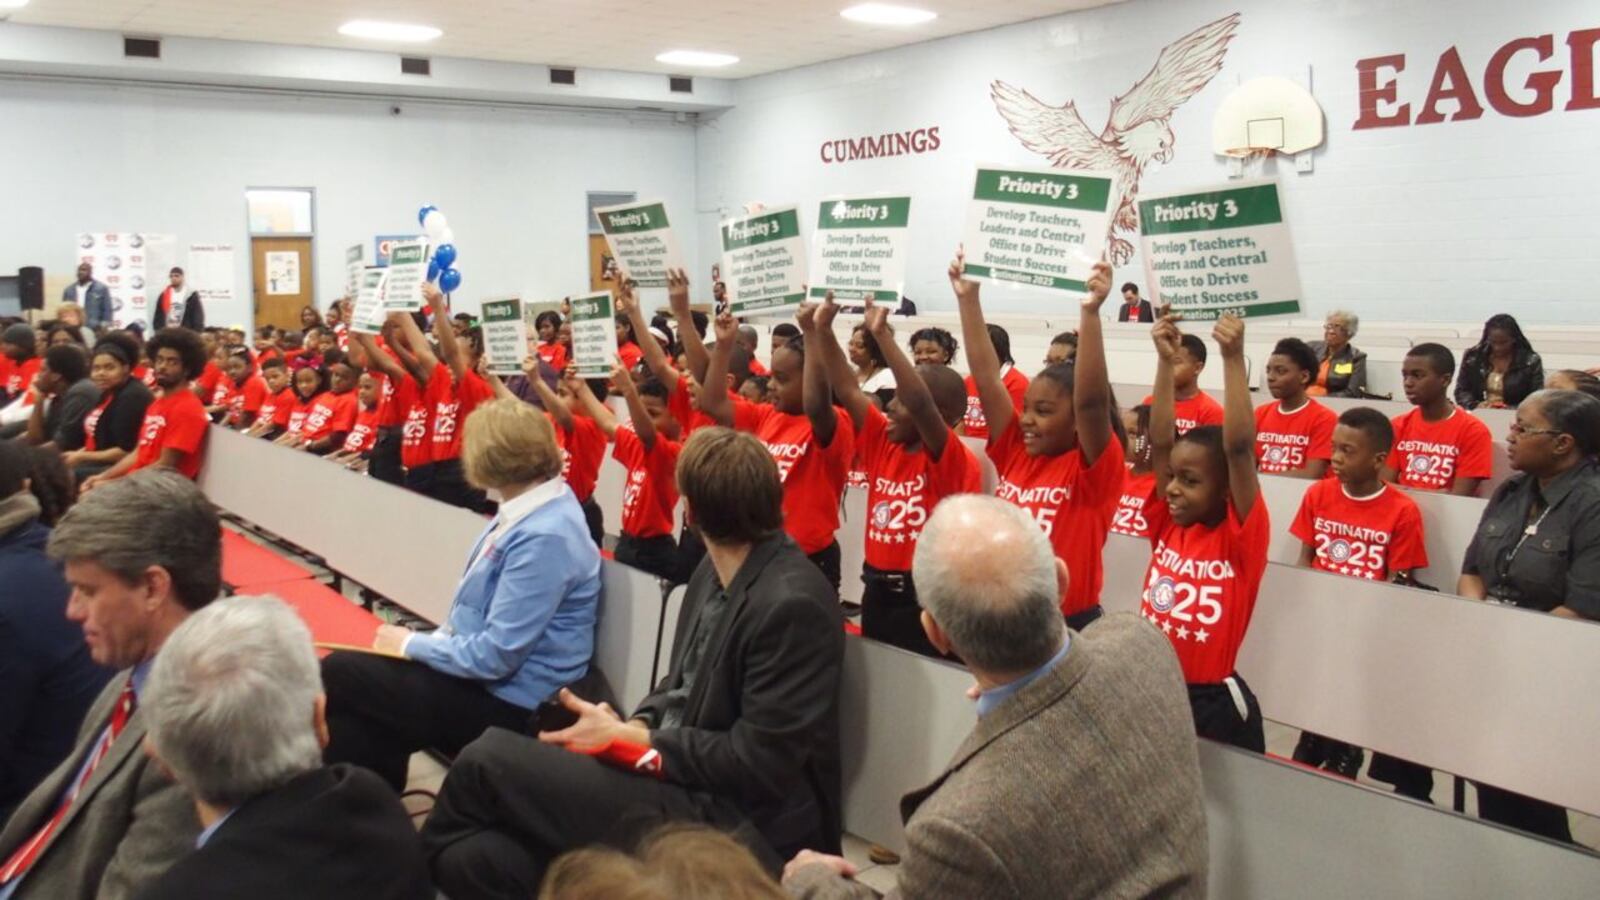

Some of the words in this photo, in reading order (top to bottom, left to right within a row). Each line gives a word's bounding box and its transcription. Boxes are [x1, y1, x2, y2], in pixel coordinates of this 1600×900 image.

[821, 126, 940, 163] CUMMINGS
[997, 175, 1064, 199] Priority
[1065, 183, 1079, 200] 3
[608, 212, 641, 227] Priority
[879, 205, 888, 220] 3
[986, 206, 1026, 223] Develop
[1029, 210, 1082, 228] Teachers,
[1154, 201, 1219, 223] Priority
[1223, 199, 1239, 217] 3
[771, 220, 780, 233] 3
[980, 221, 1016, 235] Leaders
[1018, 227, 1039, 238] and
[1041, 228, 1085, 244] Central
[989, 237, 1017, 251] Office
[1021, 243, 1032, 253] to
[1034, 242, 1067, 258] Drive
[1152, 240, 1187, 255] Develop
[1189, 236, 1256, 252] Teachers,
[983, 252, 1022, 266] Student
[1024, 257, 1068, 274] Success
[1183, 256, 1206, 270] and
[1209, 251, 1267, 267] Central
[1159, 275, 1188, 288] Office
[1191, 275, 1204, 287] to
[1207, 272, 1249, 286] Drive
[1201, 290, 1259, 304] Success
